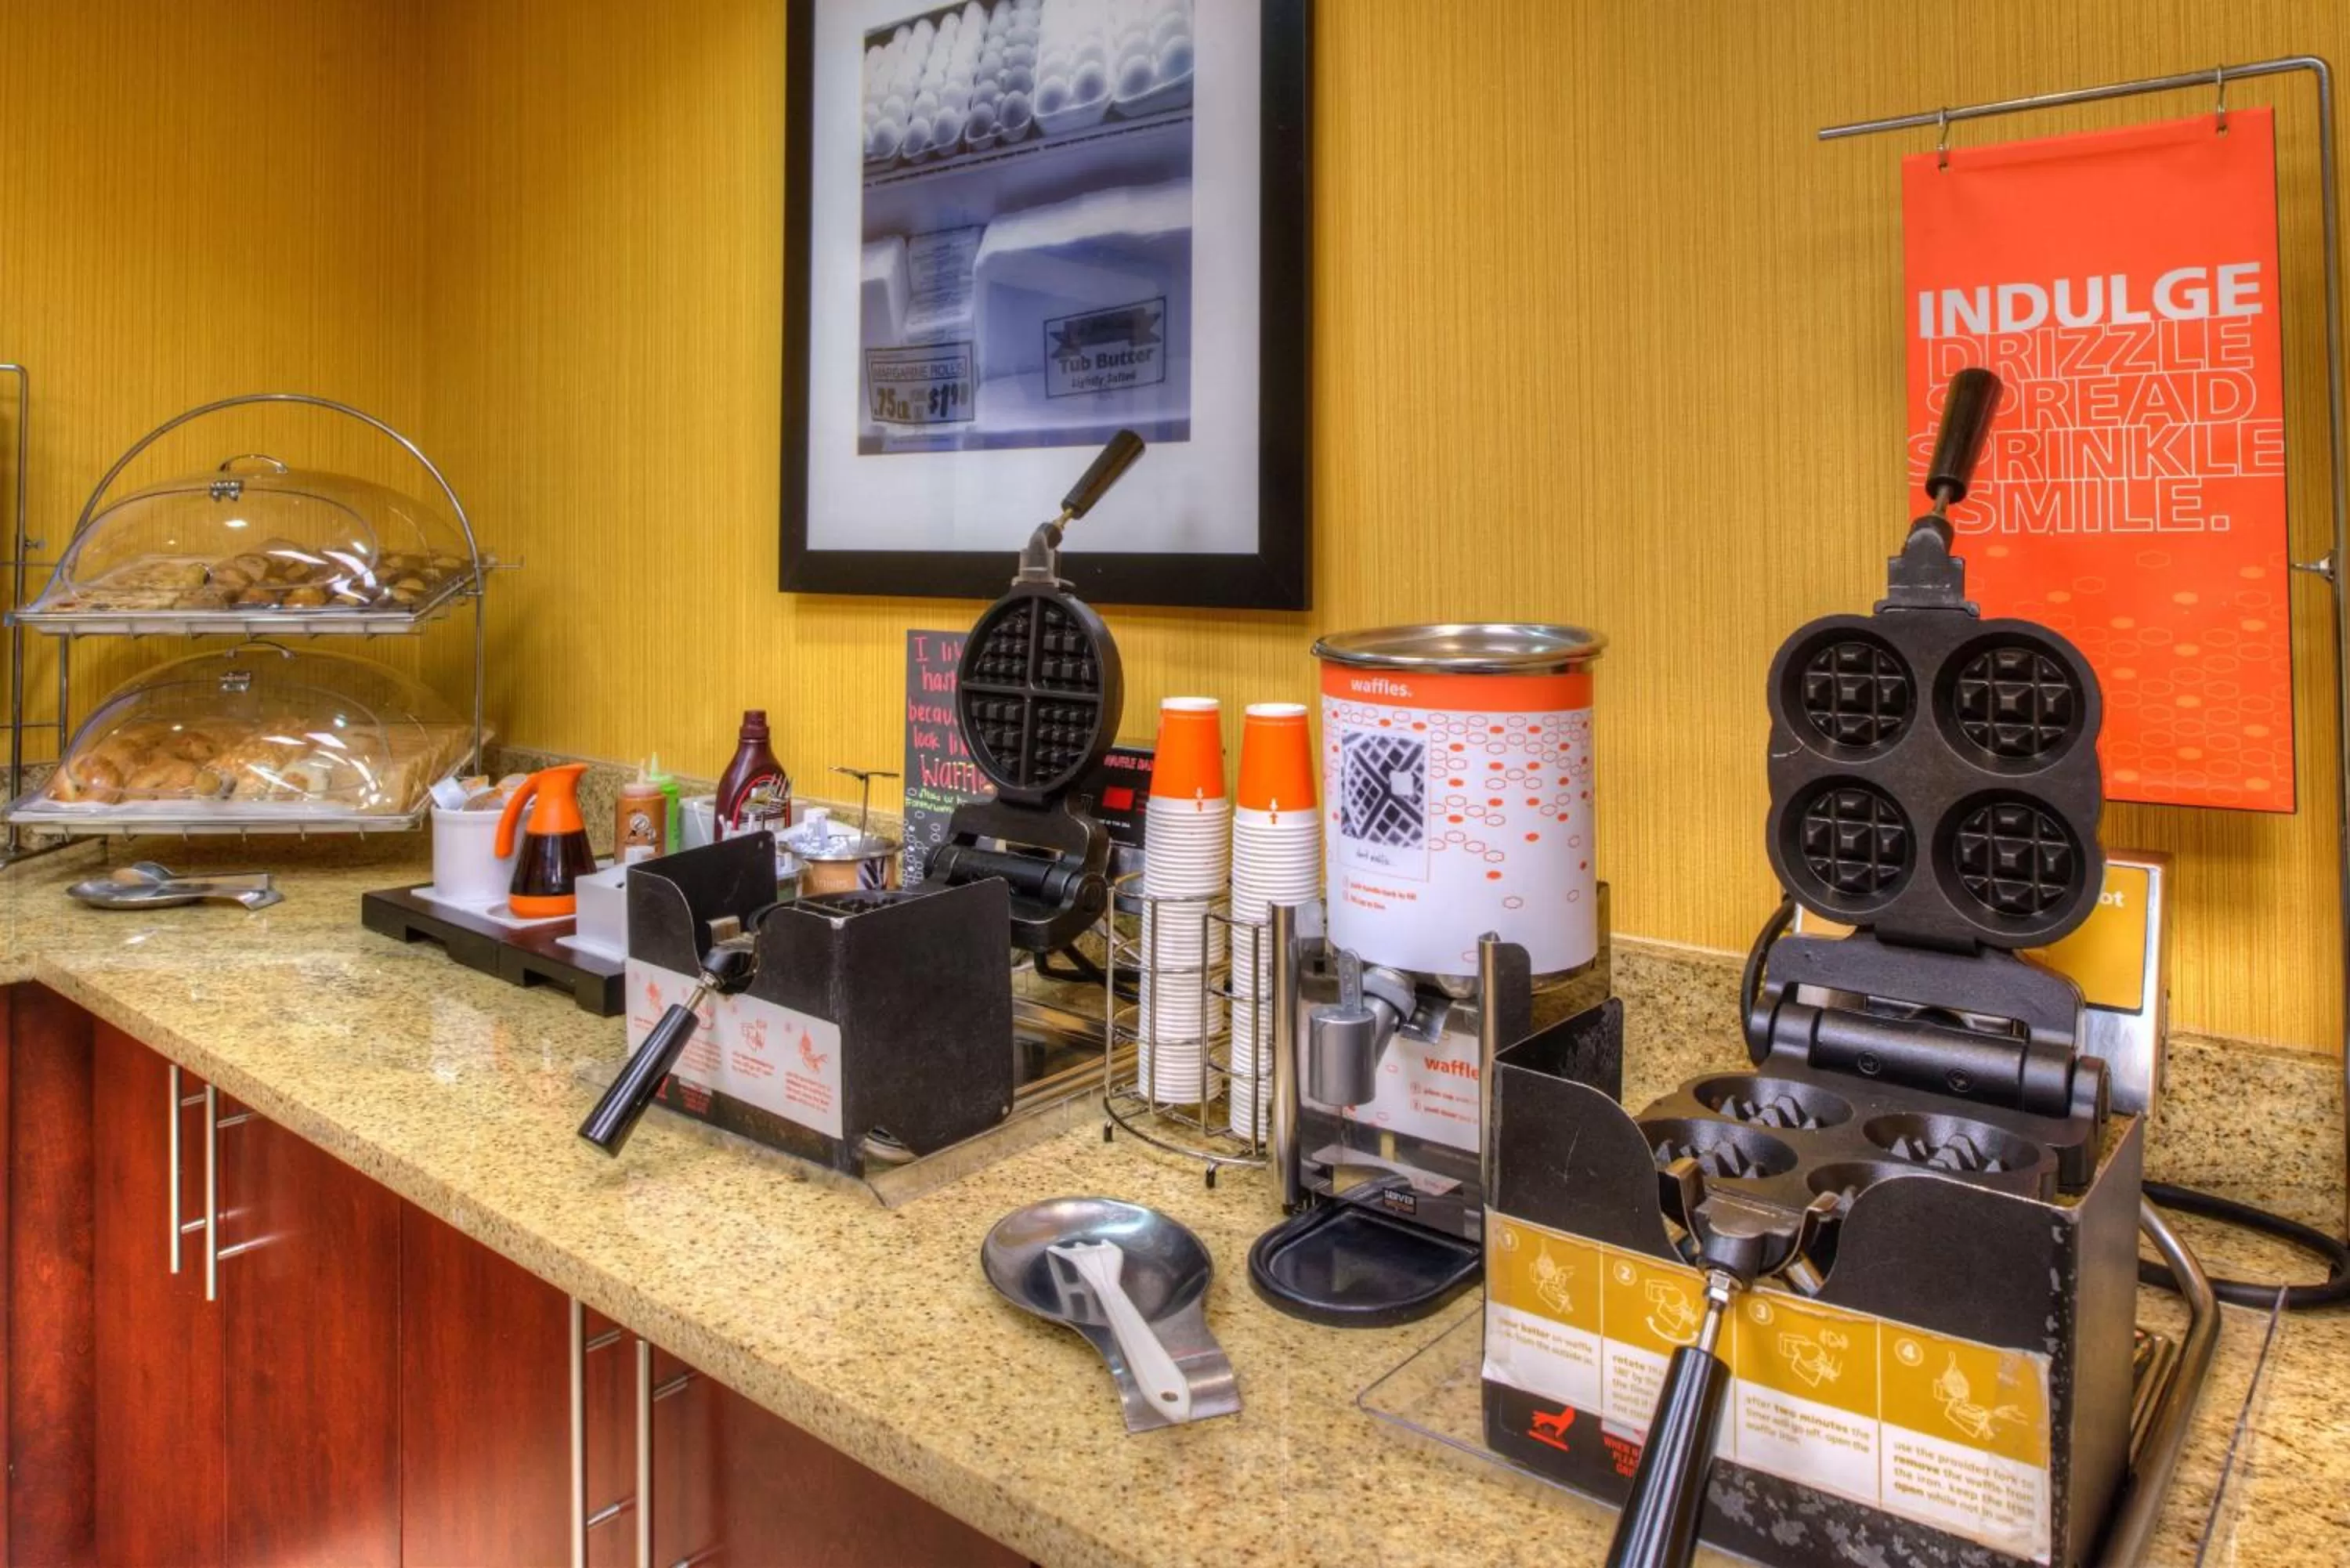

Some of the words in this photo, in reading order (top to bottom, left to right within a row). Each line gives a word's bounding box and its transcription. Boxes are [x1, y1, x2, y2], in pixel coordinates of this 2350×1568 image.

[1919, 262, 2262, 339] INDULGE
[1059, 355, 1091, 374] Tub
[1097, 348, 1156, 370] Butter
[1929, 314, 2254, 388] DRIZZLE
[1954, 476, 2230, 535] SMILE.
[915, 637, 929, 662] I
[1350, 677, 1413, 699] waffles.
[1746, 1396, 1770, 1408] after
[1774, 1404, 1796, 1418] two
[1799, 1414, 1849, 1433] minutes
[1852, 1427, 1871, 1440] the
[1746, 1421, 1776, 1436] waffle
[1853, 1440, 1871, 1454] the
[1893, 1454, 1940, 1475] remove
[1943, 1468, 1962, 1482] the
[1894, 1467, 1913, 1480] the
[1915, 1446, 1934, 1460] the
[1938, 1454, 1990, 1476] provided
